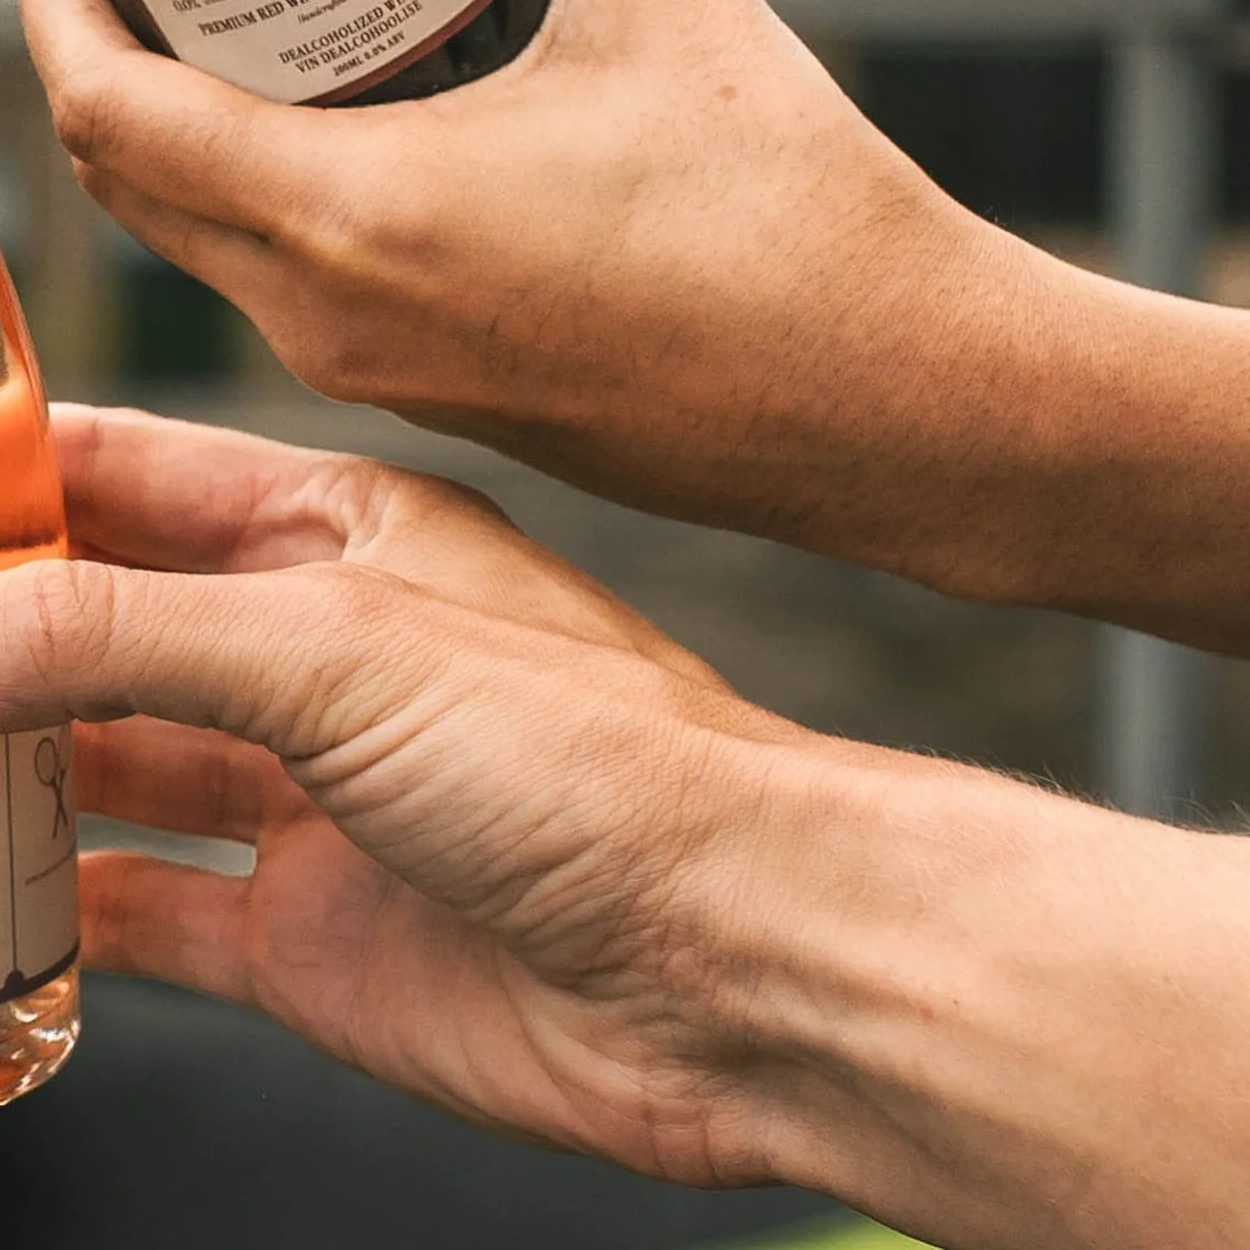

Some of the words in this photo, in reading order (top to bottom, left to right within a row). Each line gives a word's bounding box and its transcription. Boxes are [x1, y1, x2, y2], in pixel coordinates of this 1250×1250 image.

[198, 11, 258, 36] PREMIUM
[256, 1, 285, 21] RED
[278, 6, 384, 64] DEALCOHOLIZED
[294, 55, 320, 73] VIN
[319, 0, 423, 64] DEALCOHOOLISE
[386, 30, 405, 48] ABV
